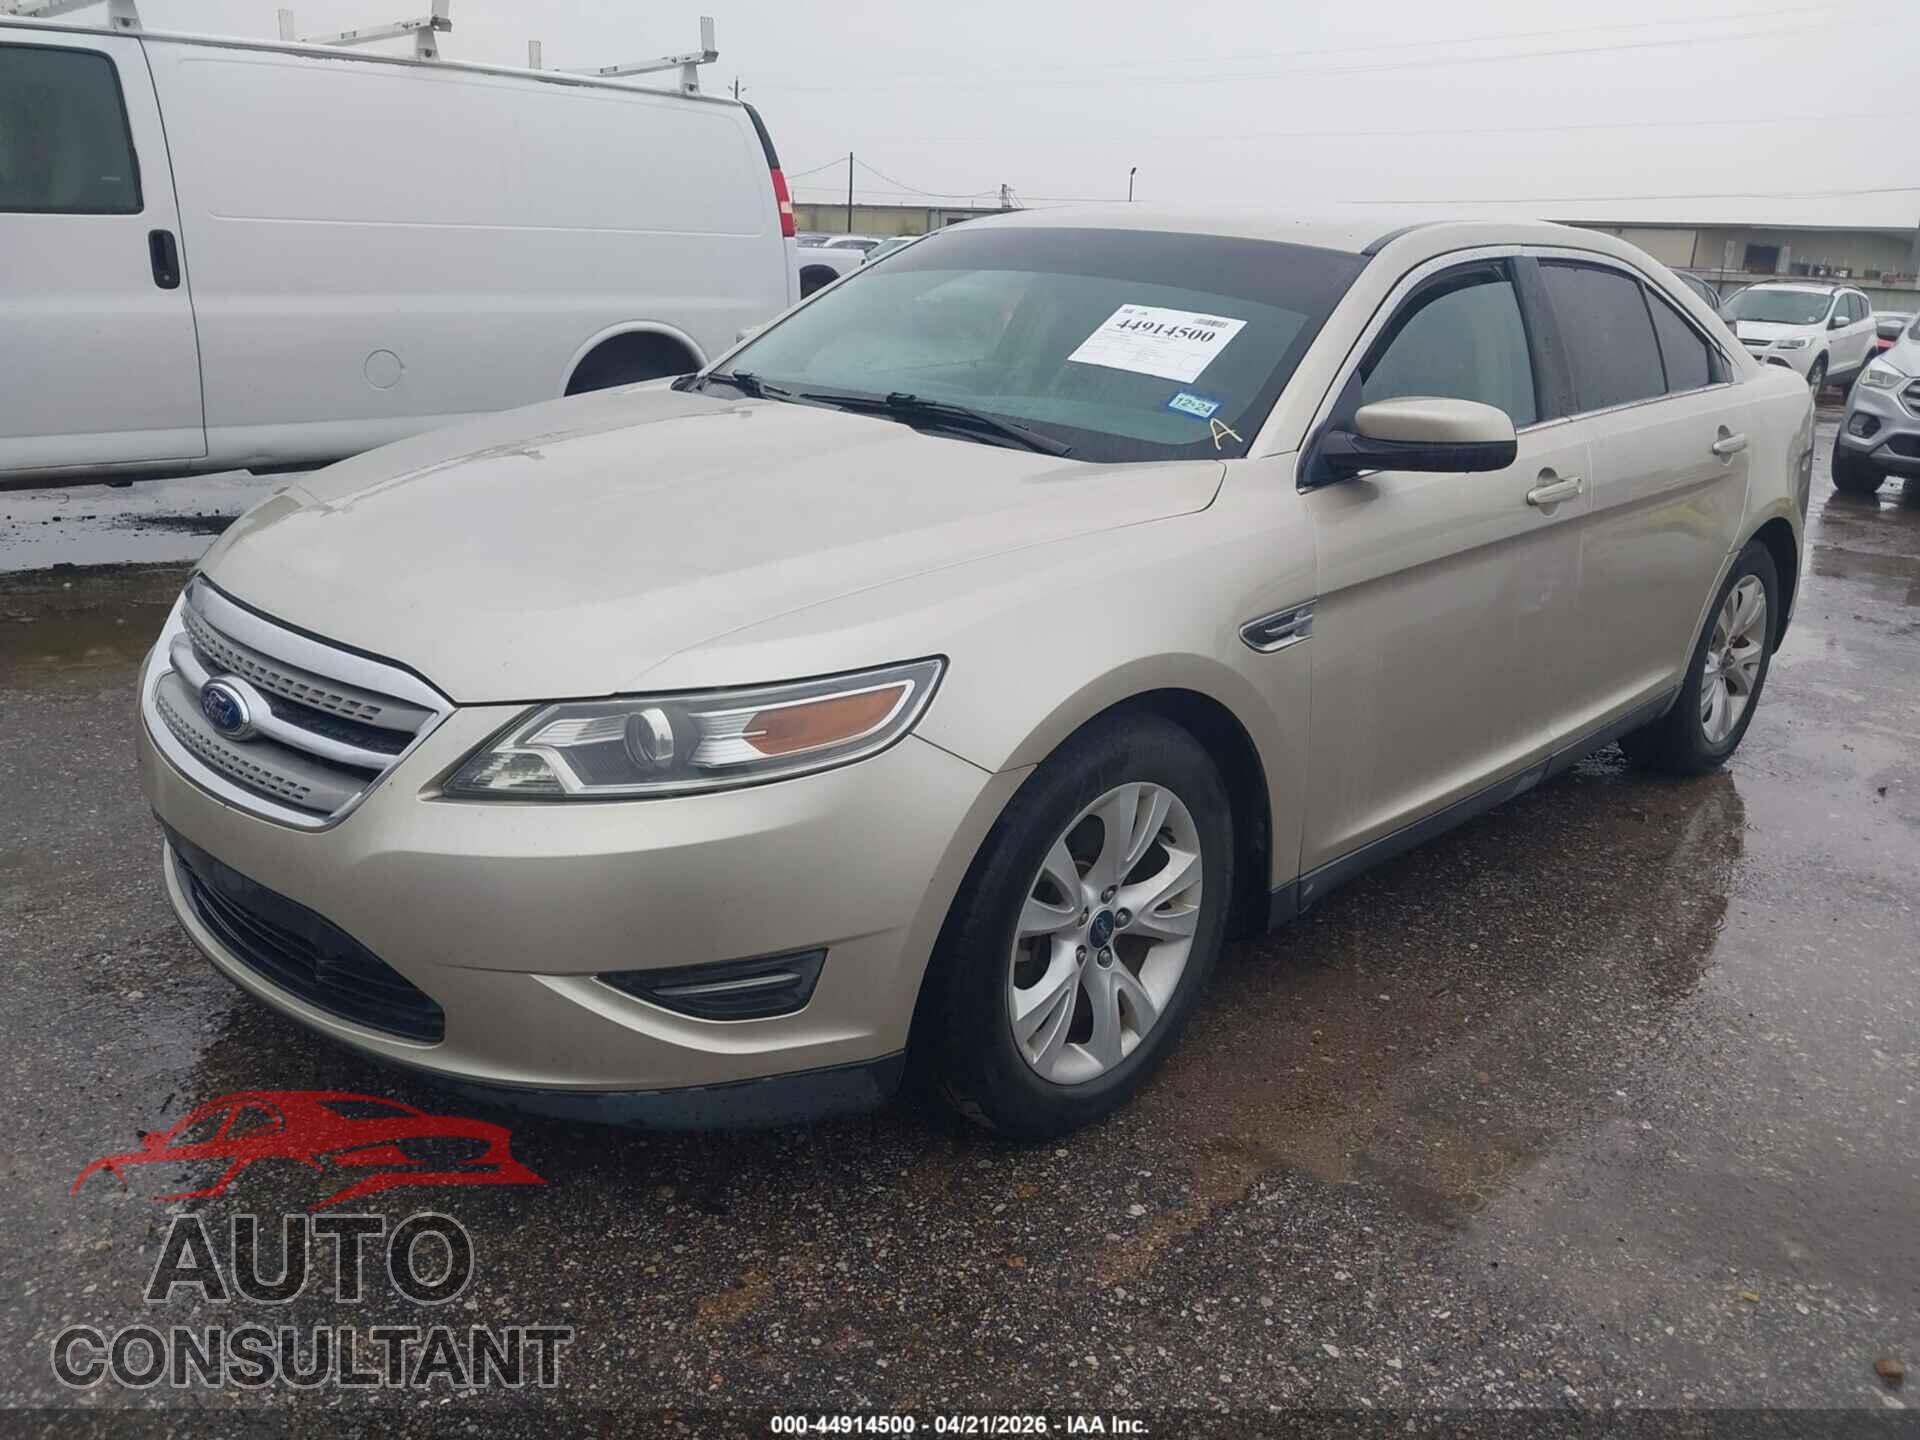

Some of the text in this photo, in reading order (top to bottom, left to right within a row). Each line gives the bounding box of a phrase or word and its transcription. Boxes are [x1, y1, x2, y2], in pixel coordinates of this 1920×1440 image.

[1116, 319, 1216, 342] 44914500
[1210, 417, 1243, 450] A
[202, 689, 232, 726] Ford
